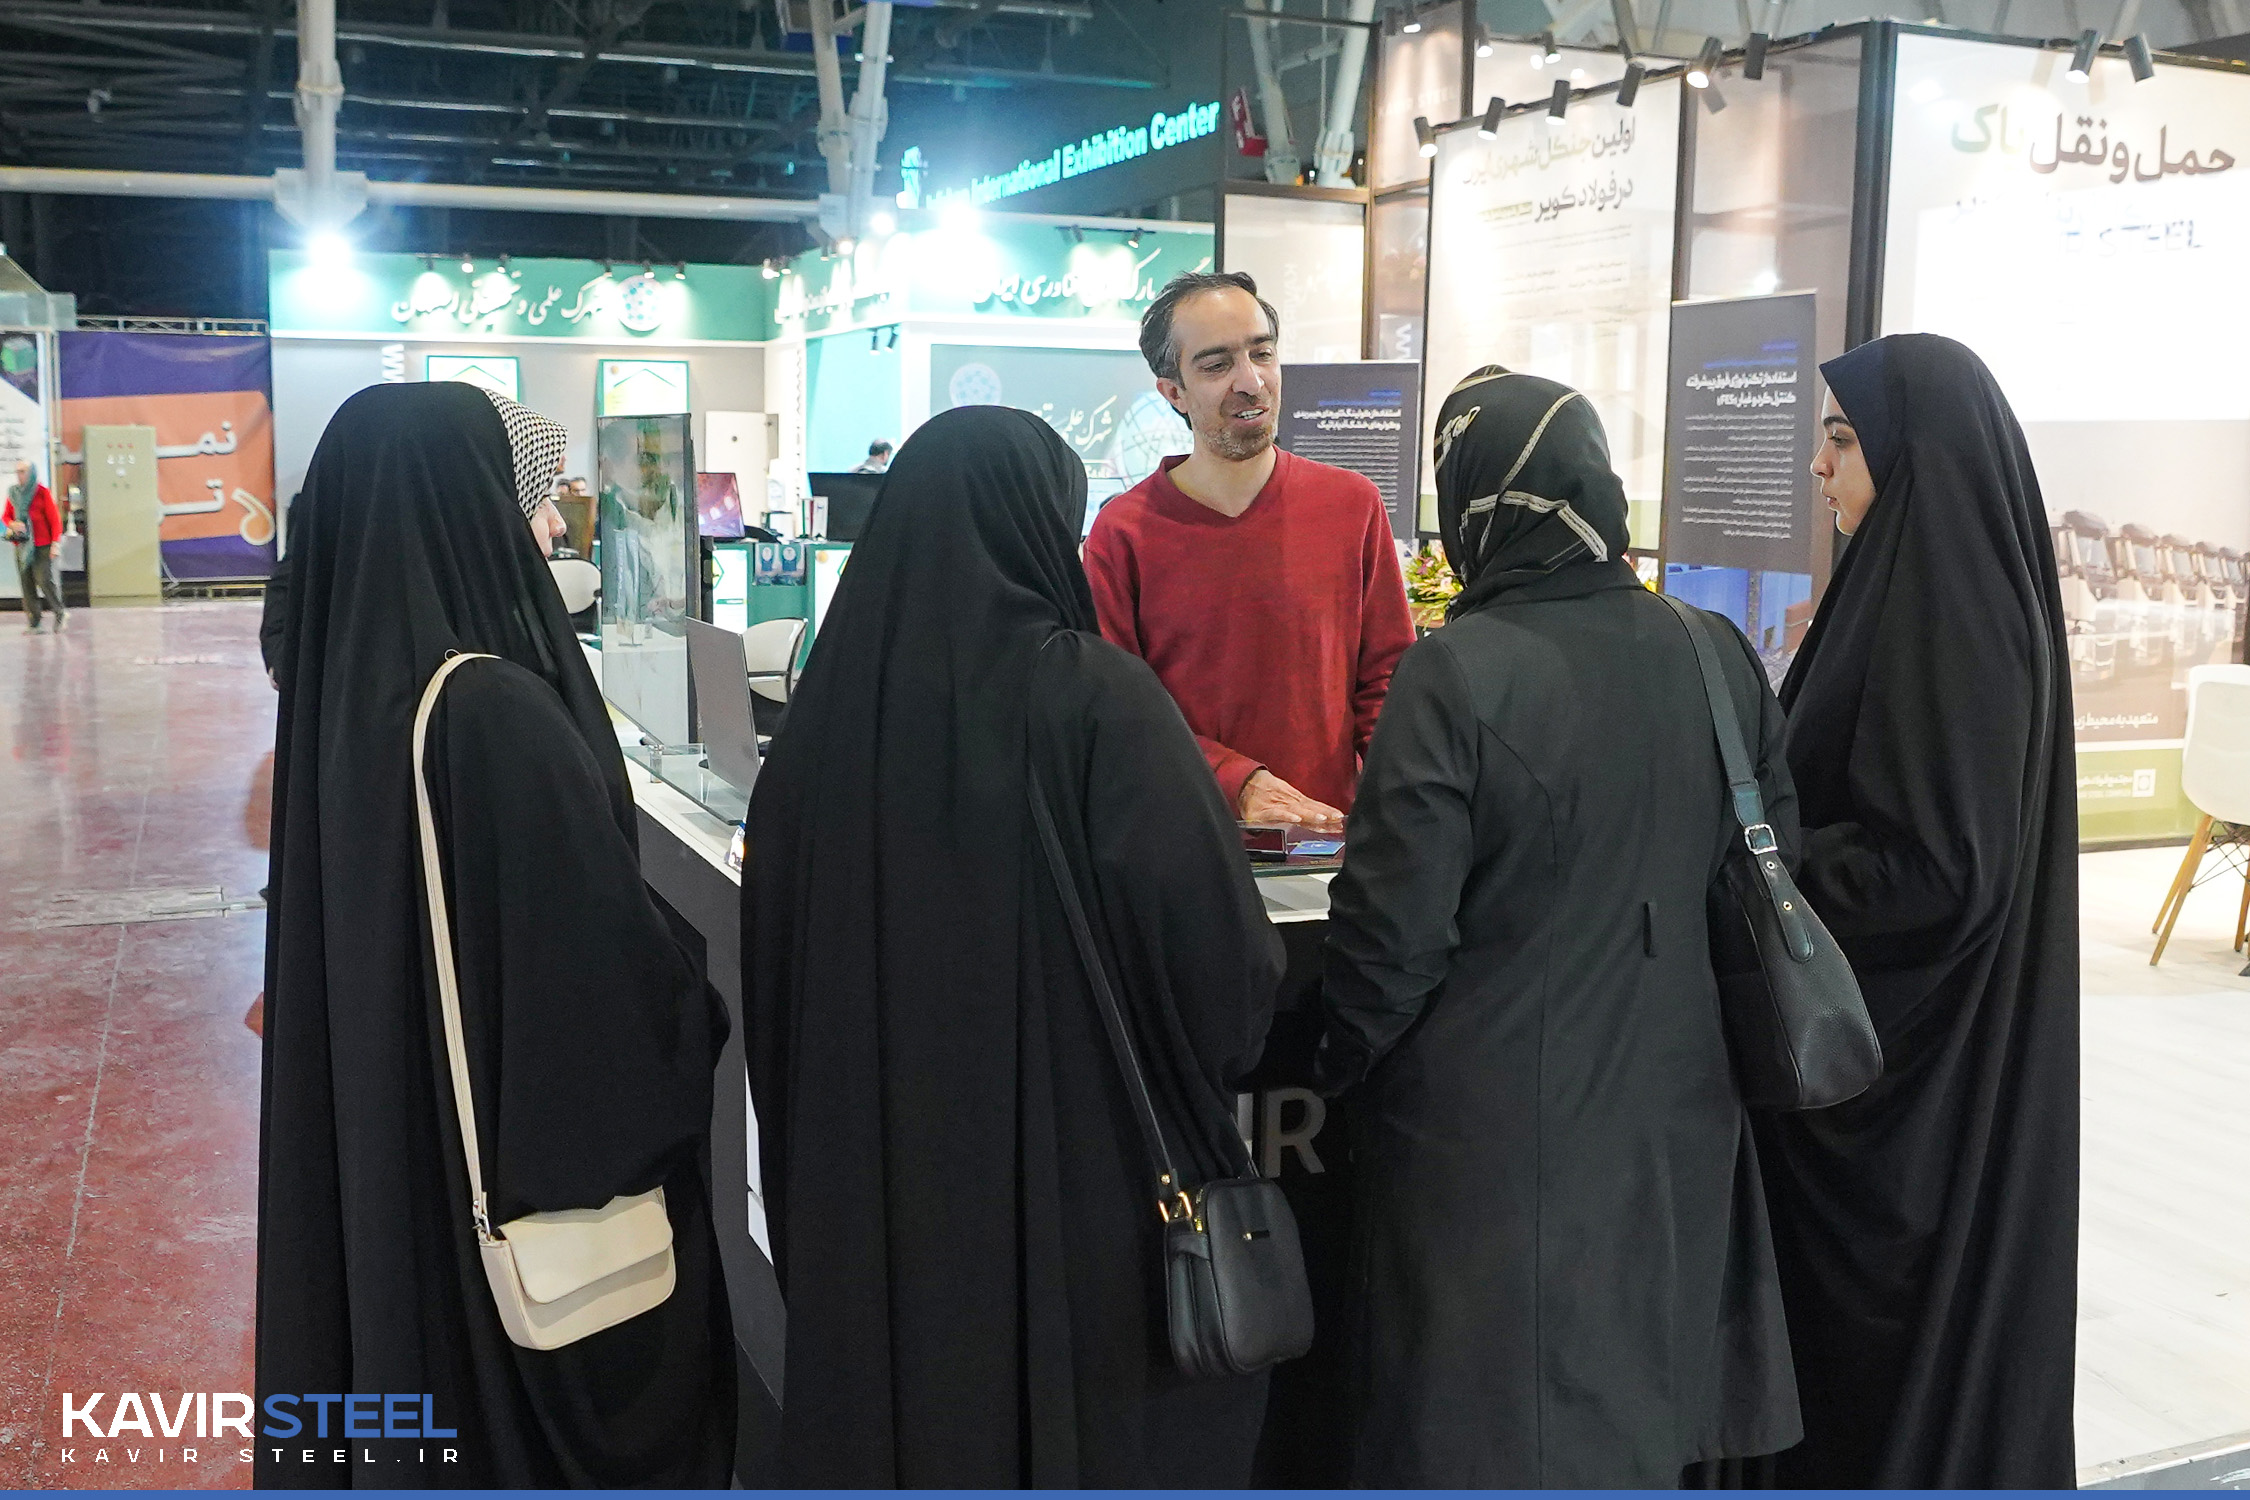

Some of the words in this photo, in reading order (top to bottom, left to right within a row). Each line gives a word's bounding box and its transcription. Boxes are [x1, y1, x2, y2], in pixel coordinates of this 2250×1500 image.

[971, 149, 1061, 205] International
[1062, 127, 1149, 179] Exhibition
[1150, 101, 1220, 150] Center
[1592, 115, 1636, 157] اولین
[2029, 112, 2108, 174] نقل
[2134, 124, 2236, 183] حمل
[2108, 141, 2130, 184] و
[1533, 185, 1577, 223] کویر
[1577, 169, 1617, 212] فولاد
